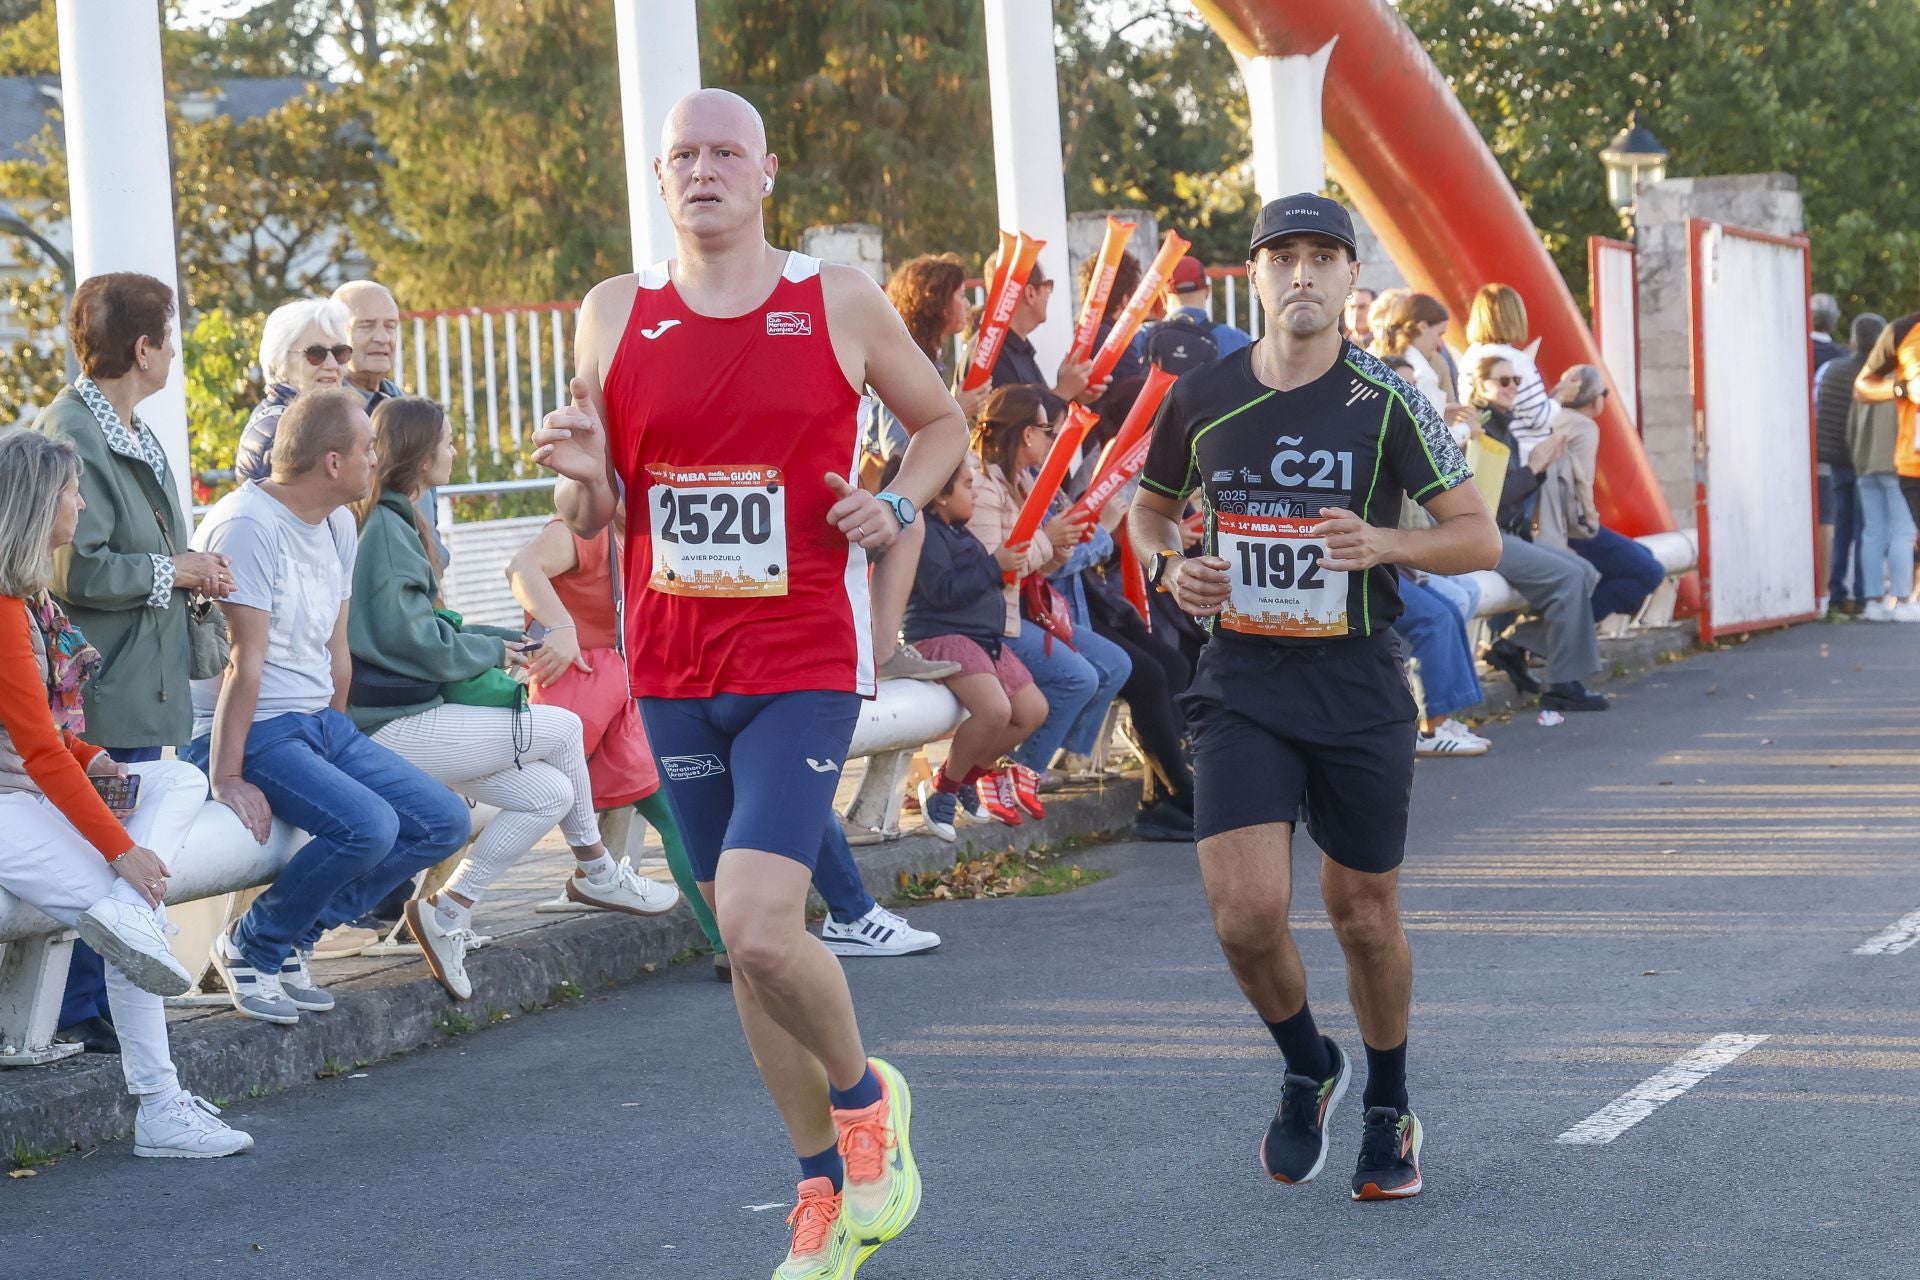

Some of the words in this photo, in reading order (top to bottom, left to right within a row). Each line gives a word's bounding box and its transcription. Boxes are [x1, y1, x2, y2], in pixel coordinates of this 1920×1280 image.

[1285, 208, 1319, 216] KIPRUN
[995, 280, 1022, 322] MBA
[974, 325, 1001, 369] MBA
[677, 472, 706, 482] MBA
[730, 469, 761, 481] GIJÓN
[1085, 471, 1126, 511] MBA
[1217, 490, 1247, 501] 2025
[660, 492, 772, 545] 2520
[1251, 523, 1278, 533] MBA
[1236, 540, 1325, 590] 1192
[1274, 596, 1301, 605] GARCÍA
[666, 765, 701, 773] Marathon
[670, 770, 701, 778] Aranjuez
